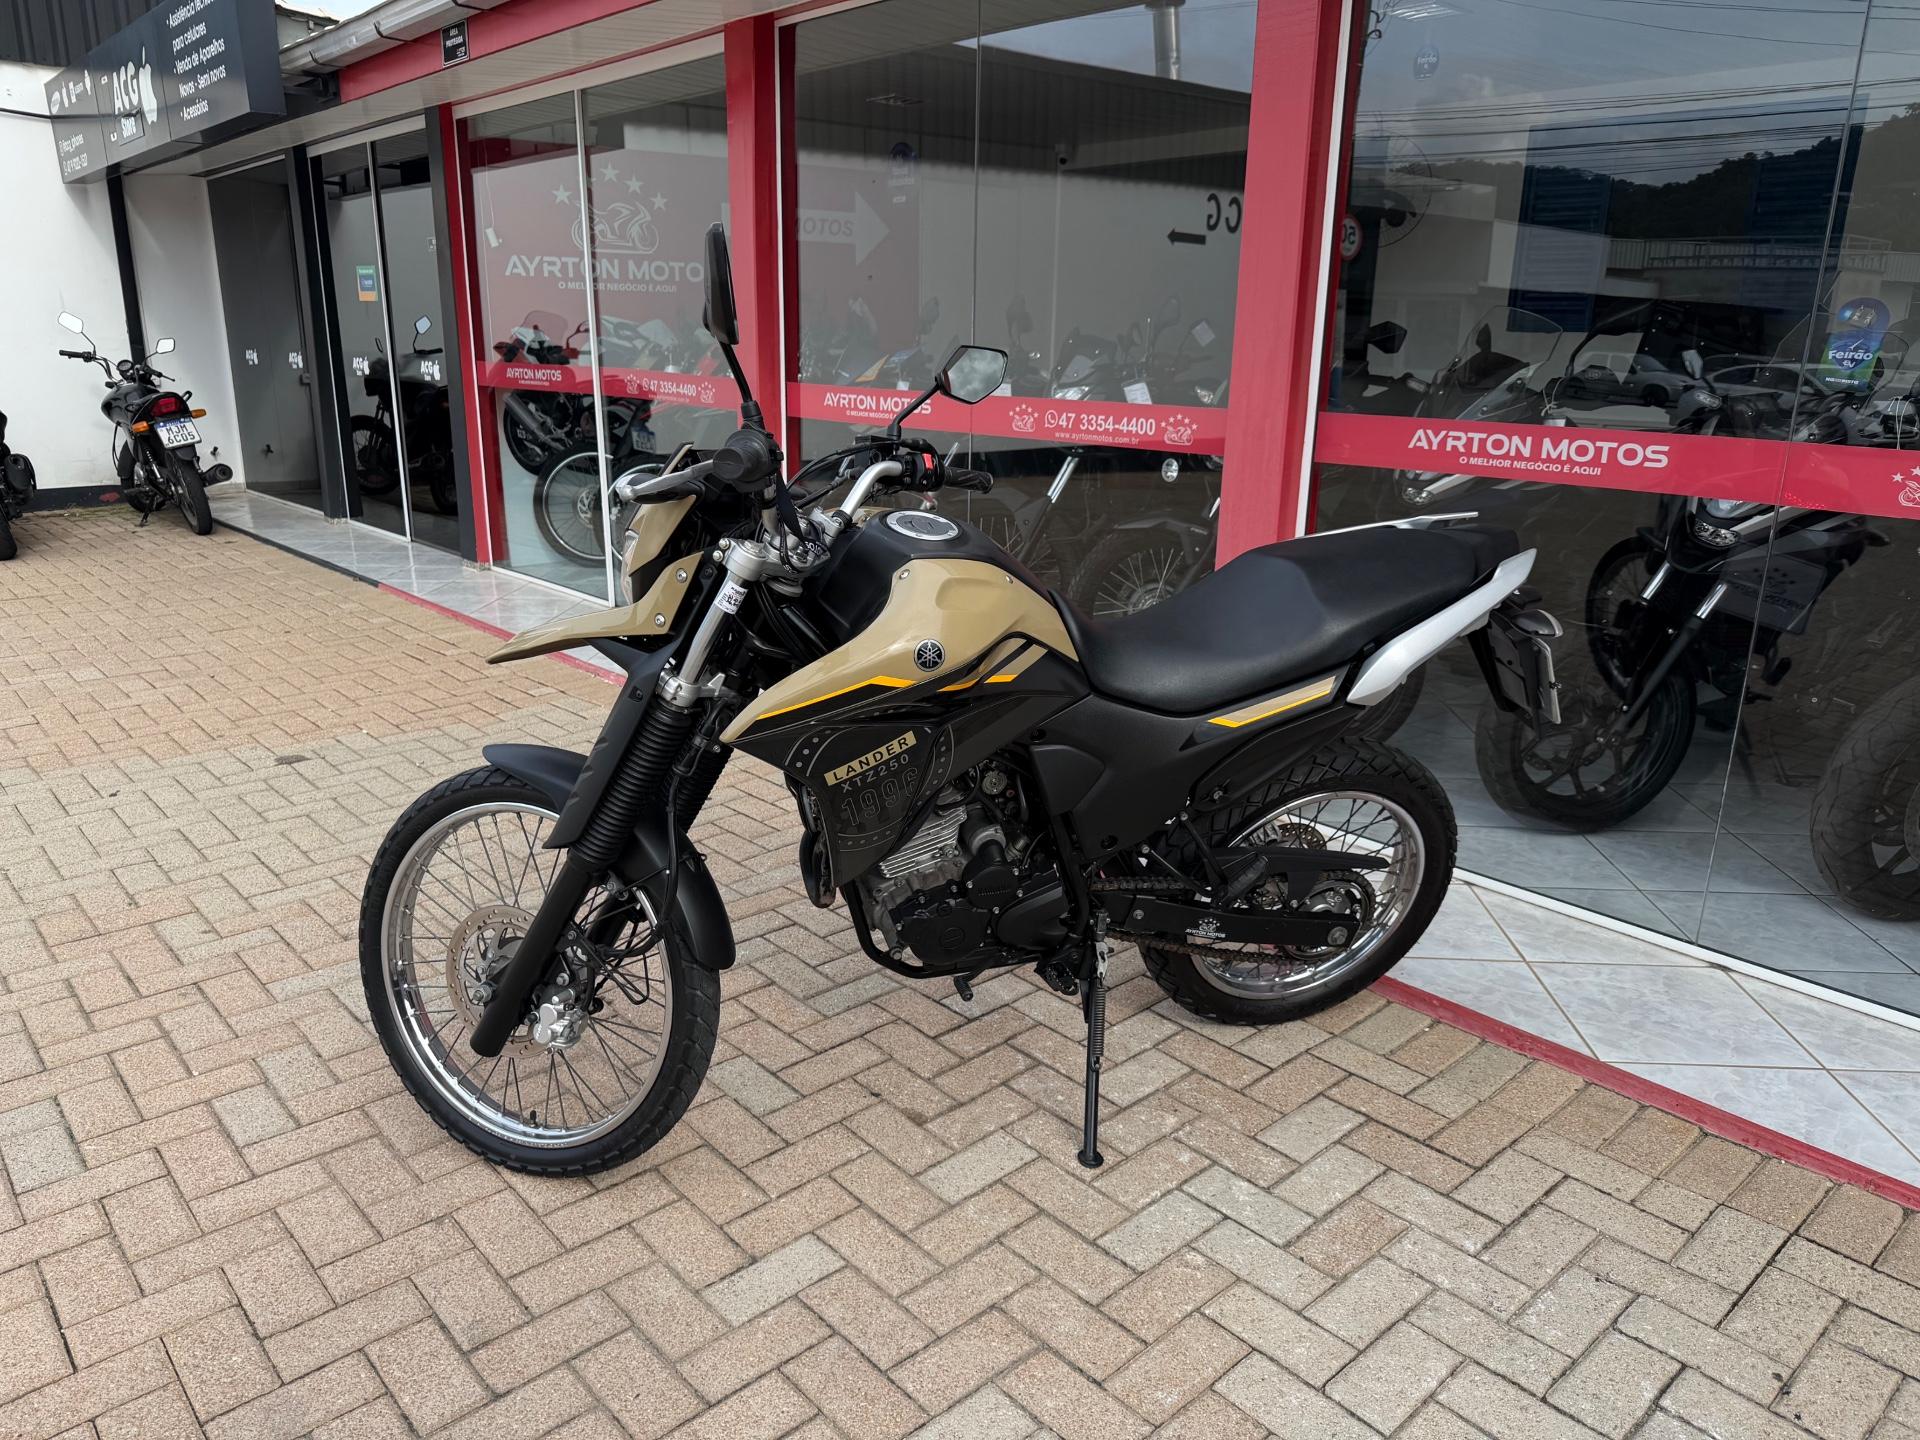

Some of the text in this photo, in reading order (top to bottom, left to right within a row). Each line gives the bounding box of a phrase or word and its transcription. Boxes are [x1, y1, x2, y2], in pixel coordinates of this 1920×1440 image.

[175, 38, 225, 75] Venda de Aparelhos
[113, 61, 139, 115] ACG
[179, 81, 195, 98] Novos
[797, 217, 853, 237] OTOS
[628, 258, 705, 282] MOTO
[567, 281, 606, 291] MELOR
[1828, 350, 1873, 360] Feirão
[421, 361, 433, 374] ACG
[506, 367, 562, 381] AYRTON MOTOS
[650, 380, 697, 397] 47 3354-4400
[824, 392, 876, 410] AYRTON
[165, 423, 189, 436] MJM
[1058, 412, 1156, 436] 47 3354-4400
[1055, 431, 1140, 445] www.ayrtonmotos.com.br
[1408, 428, 1670, 468] AYRTON MOTOS
[1459, 456, 1601, 476] O MELHOR NEGÓCIO É AQUI
[833, 737, 909, 781] LANDER
[840, 753, 909, 793] XTZ250
